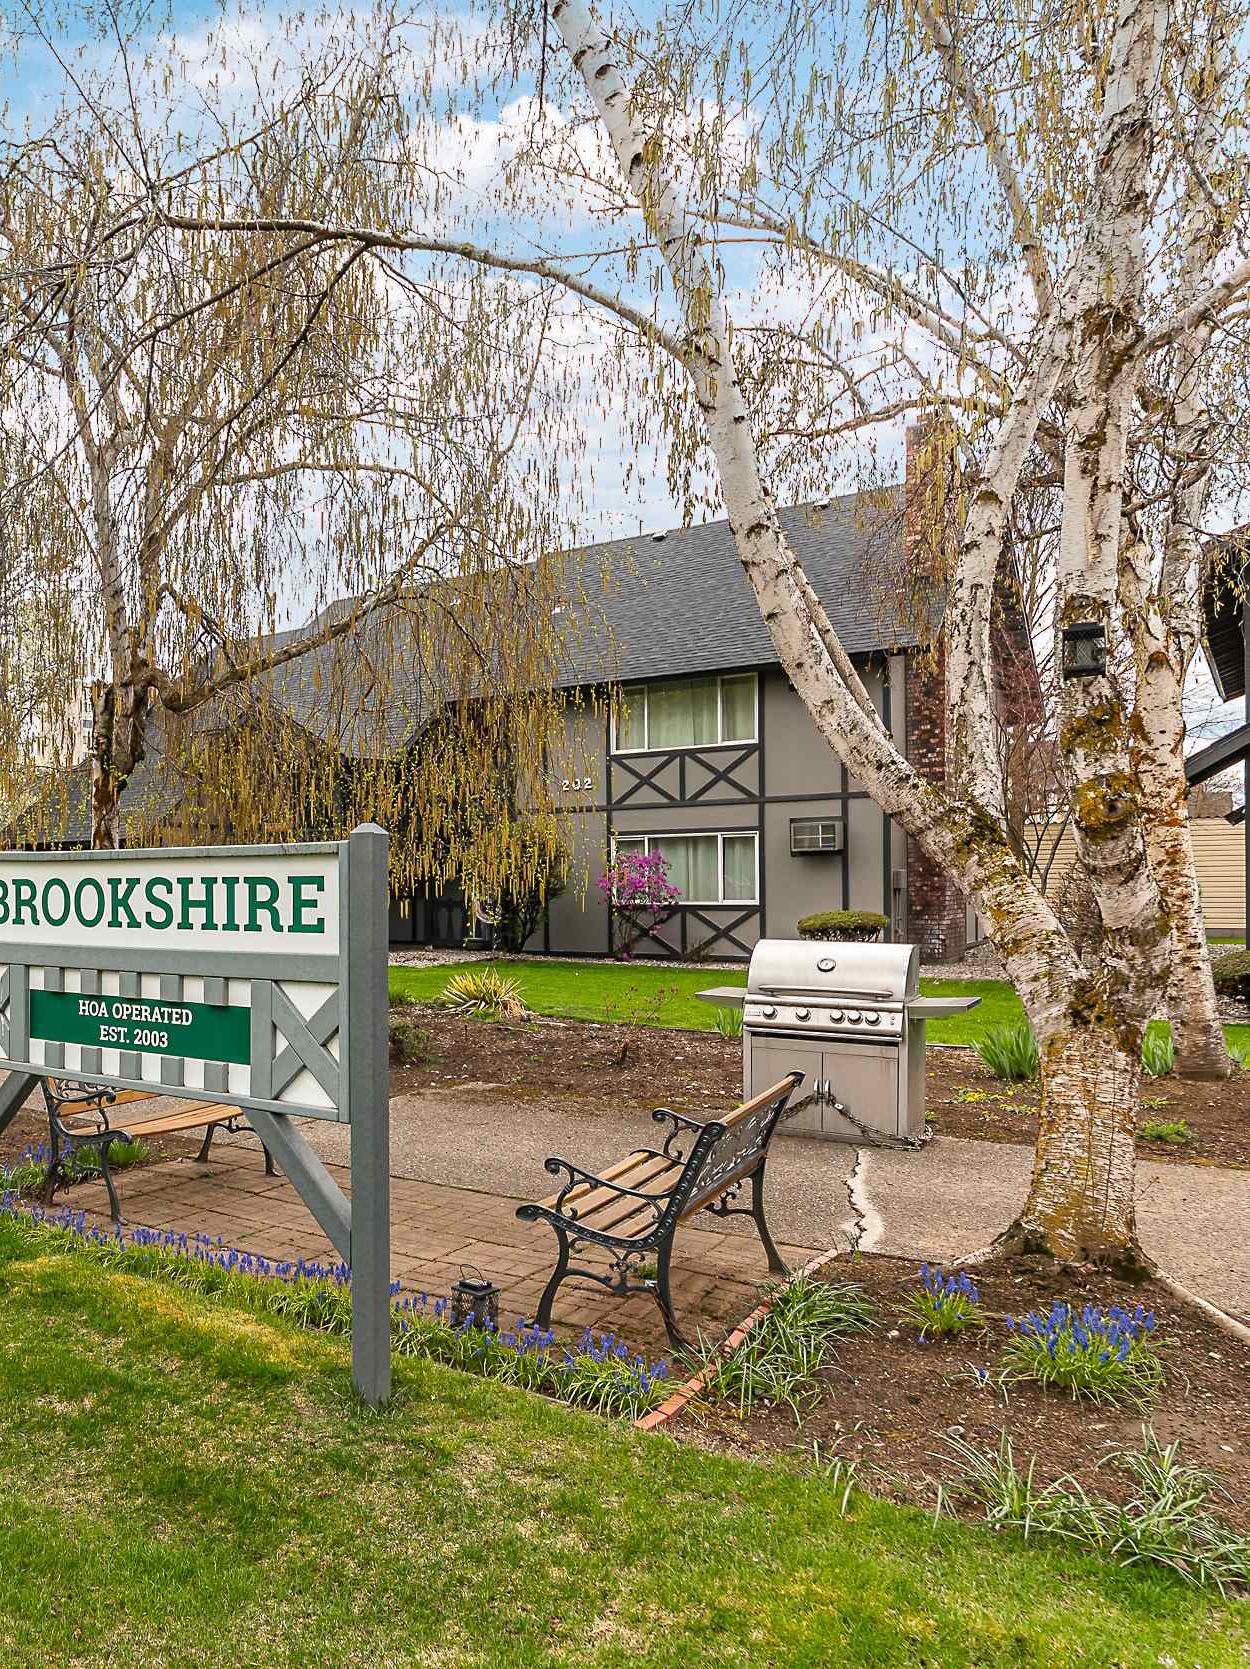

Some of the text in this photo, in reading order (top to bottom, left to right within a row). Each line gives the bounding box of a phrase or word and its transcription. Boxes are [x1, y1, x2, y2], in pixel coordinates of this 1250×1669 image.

[78, 999, 193, 1026] HOA OPERATED
[99, 1025, 168, 1048] EST. 2003
